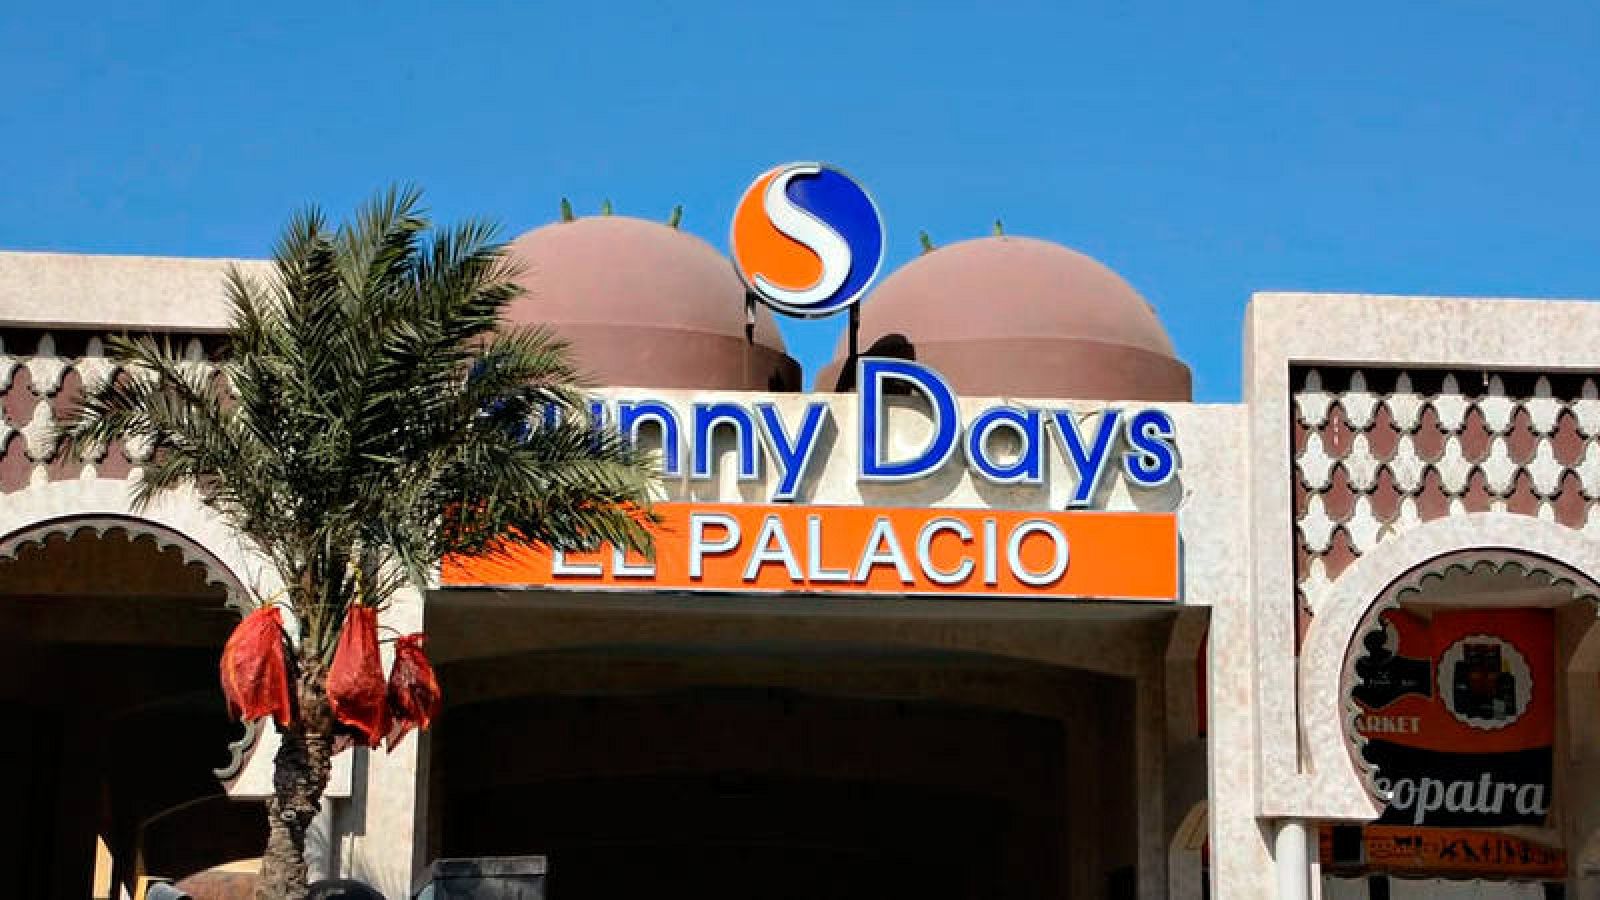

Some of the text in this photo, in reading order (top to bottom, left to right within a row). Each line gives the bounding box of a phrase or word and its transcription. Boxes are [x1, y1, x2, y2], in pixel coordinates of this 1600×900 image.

[467, 357, 1177, 508] nny Days
[688, 511, 1070, 587] PALACIO
